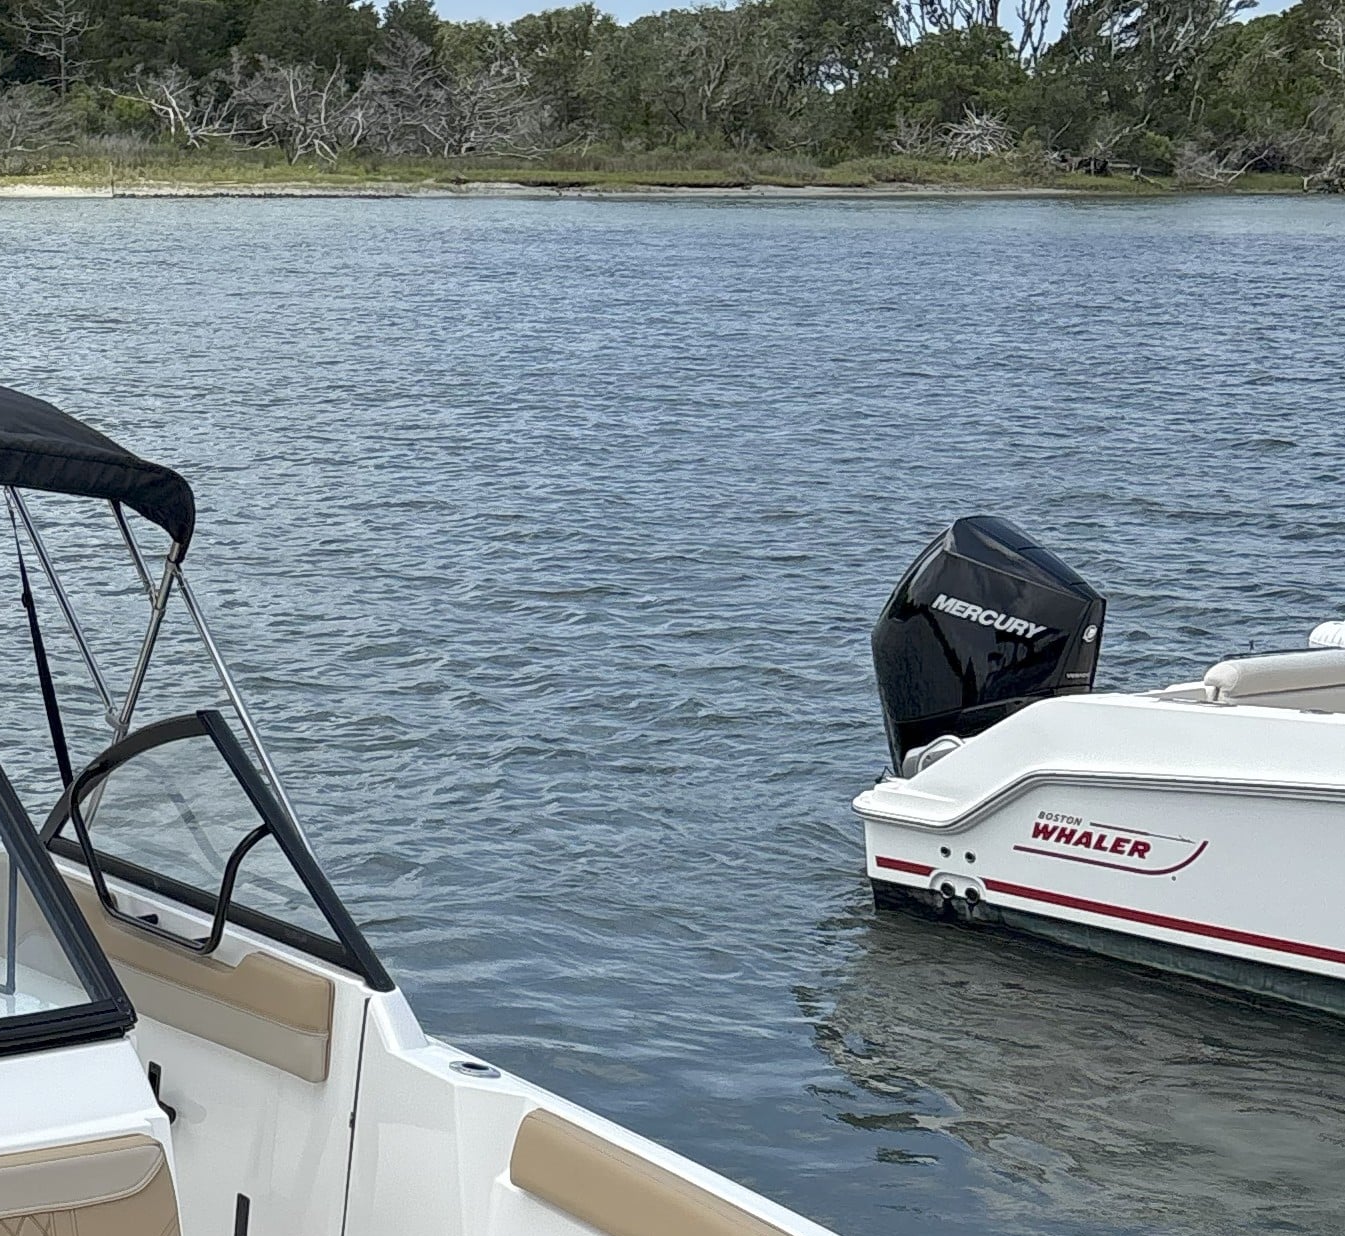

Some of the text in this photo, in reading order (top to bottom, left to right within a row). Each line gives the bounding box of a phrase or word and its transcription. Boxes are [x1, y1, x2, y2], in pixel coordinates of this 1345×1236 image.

[931, 593, 1048, 639] MERCURY
[1037, 811, 1083, 826] BOSTON
[1031, 821, 1151, 860] WHALER
